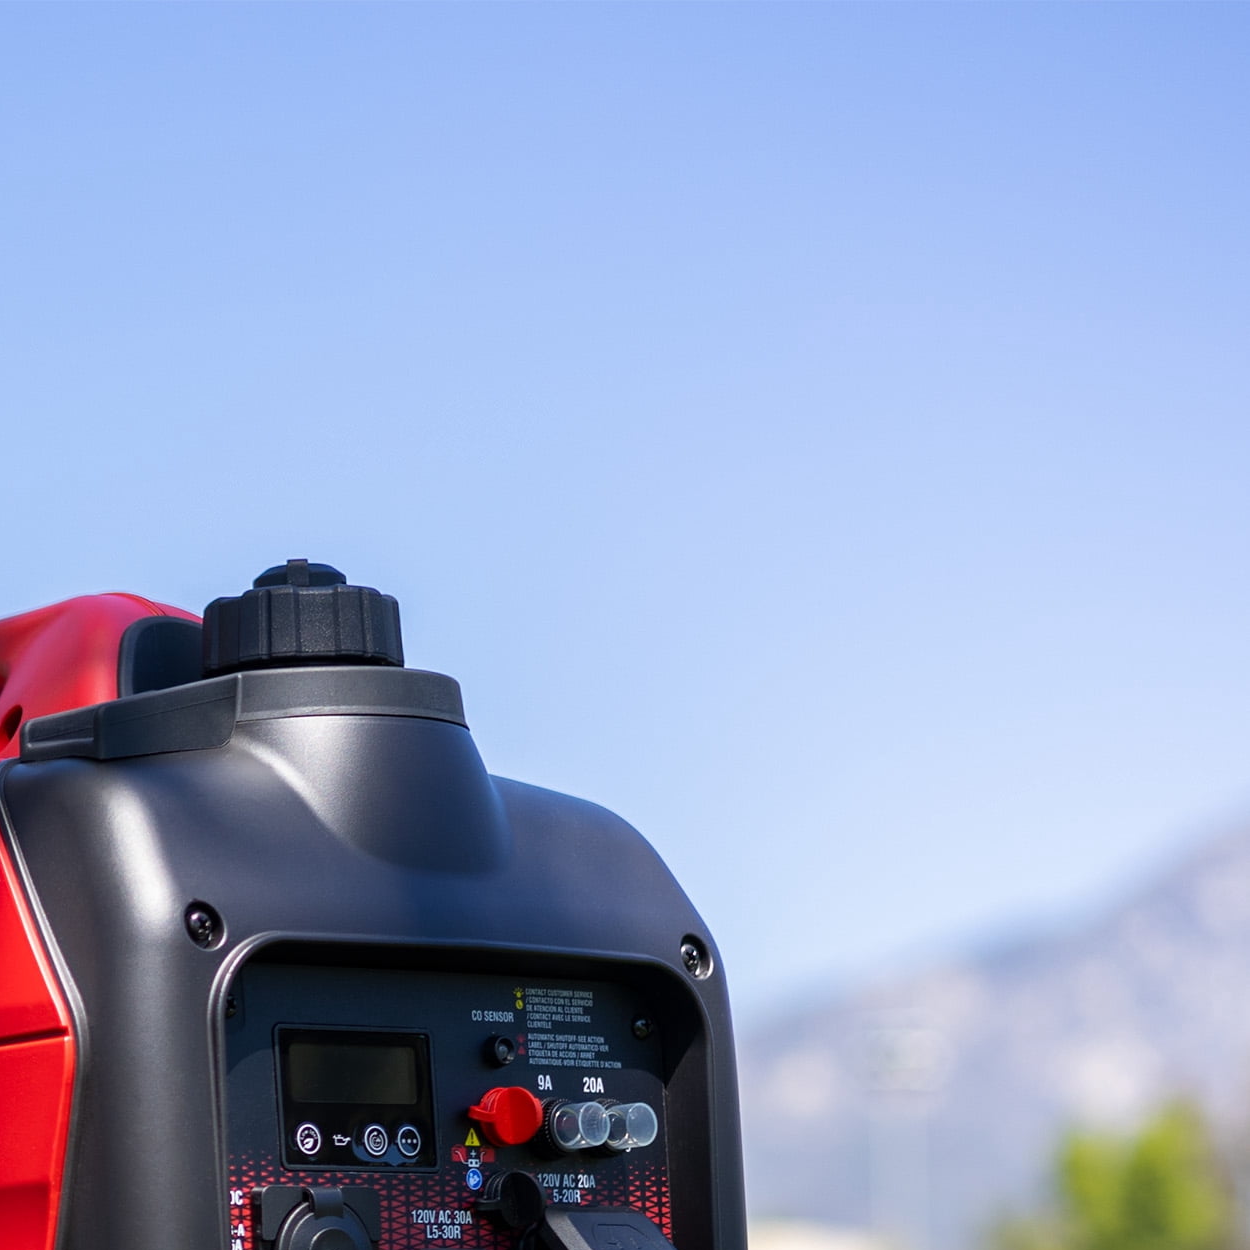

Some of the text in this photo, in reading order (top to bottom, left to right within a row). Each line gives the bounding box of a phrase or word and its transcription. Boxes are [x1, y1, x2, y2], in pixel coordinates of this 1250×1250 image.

[472, 1010, 514, 1022] CO SENSOR
[564, 1006, 583, 1014] CLIENTE
[572, 1015, 591, 1023] SERVICE
[528, 1033, 554, 1041] AUTOMATIC
[588, 1036, 604, 1044] ACTION
[537, 1074, 553, 1090] 9A
[583, 1076, 604, 1093] 20A
[537, 1174, 596, 1188] 120V AC 20A
[553, 1189, 581, 1203] 5-20R
[412, 1210, 472, 1224] 120V AC 30A
[426, 1225, 461, 1239] L5-30R
